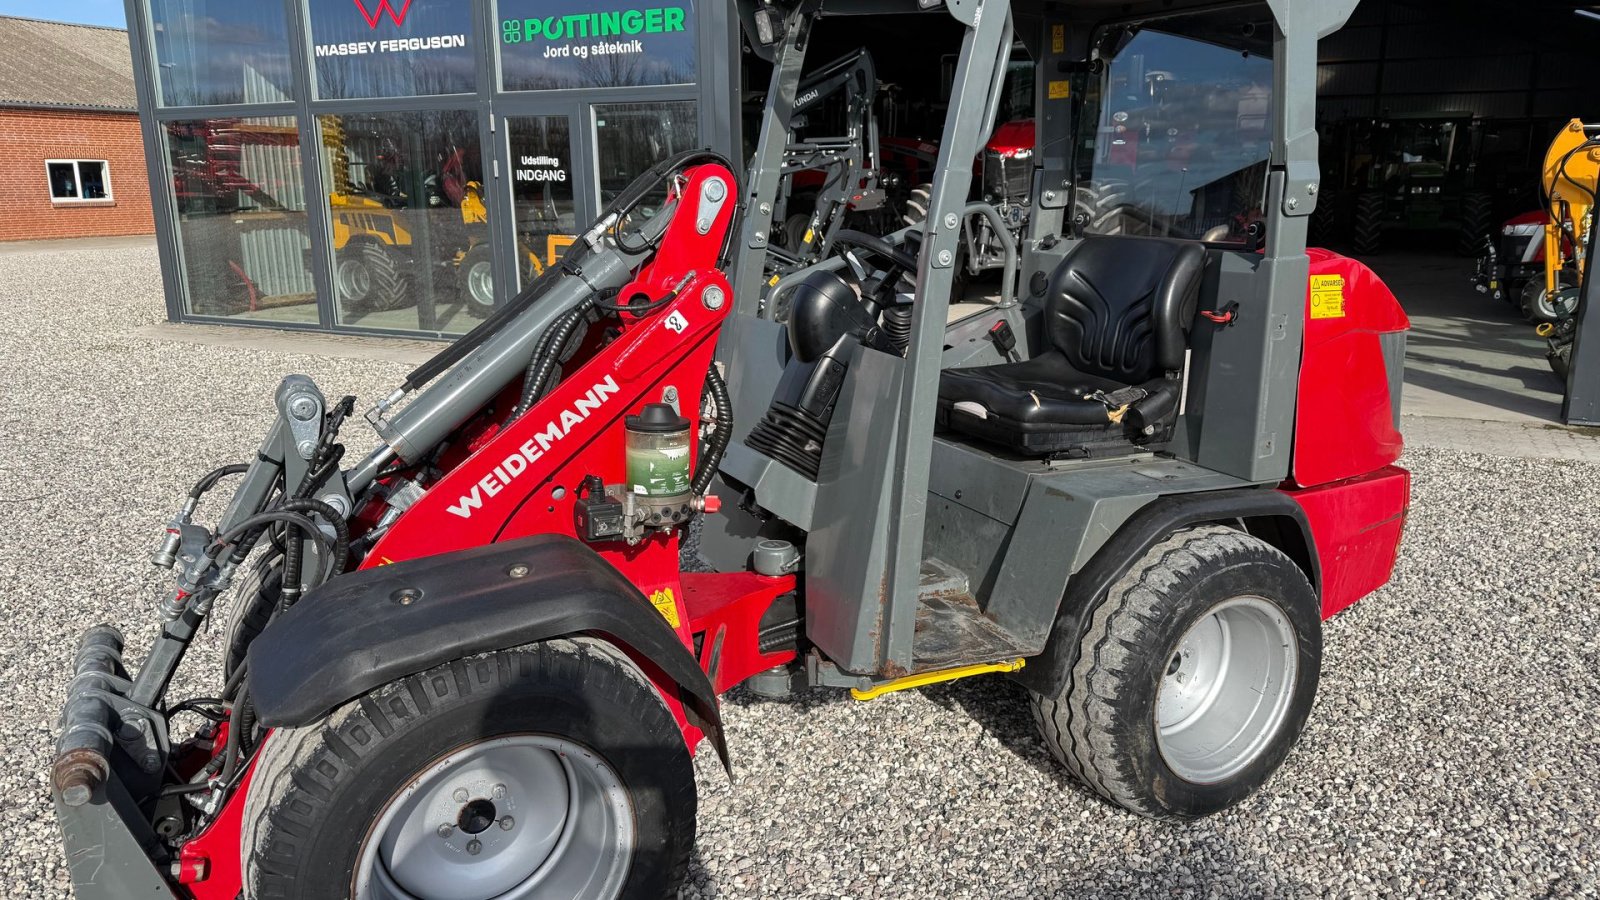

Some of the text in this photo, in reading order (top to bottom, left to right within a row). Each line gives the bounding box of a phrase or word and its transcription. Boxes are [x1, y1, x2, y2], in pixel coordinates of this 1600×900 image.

[315, 34, 465, 57] MASSEY FERGUSON
[543, 40, 643, 59] Jord og såteknik
[521, 155, 559, 168] Udstilling
[516, 169, 566, 182] INDGANG
[445, 374, 621, 519] WEIDEMANN
